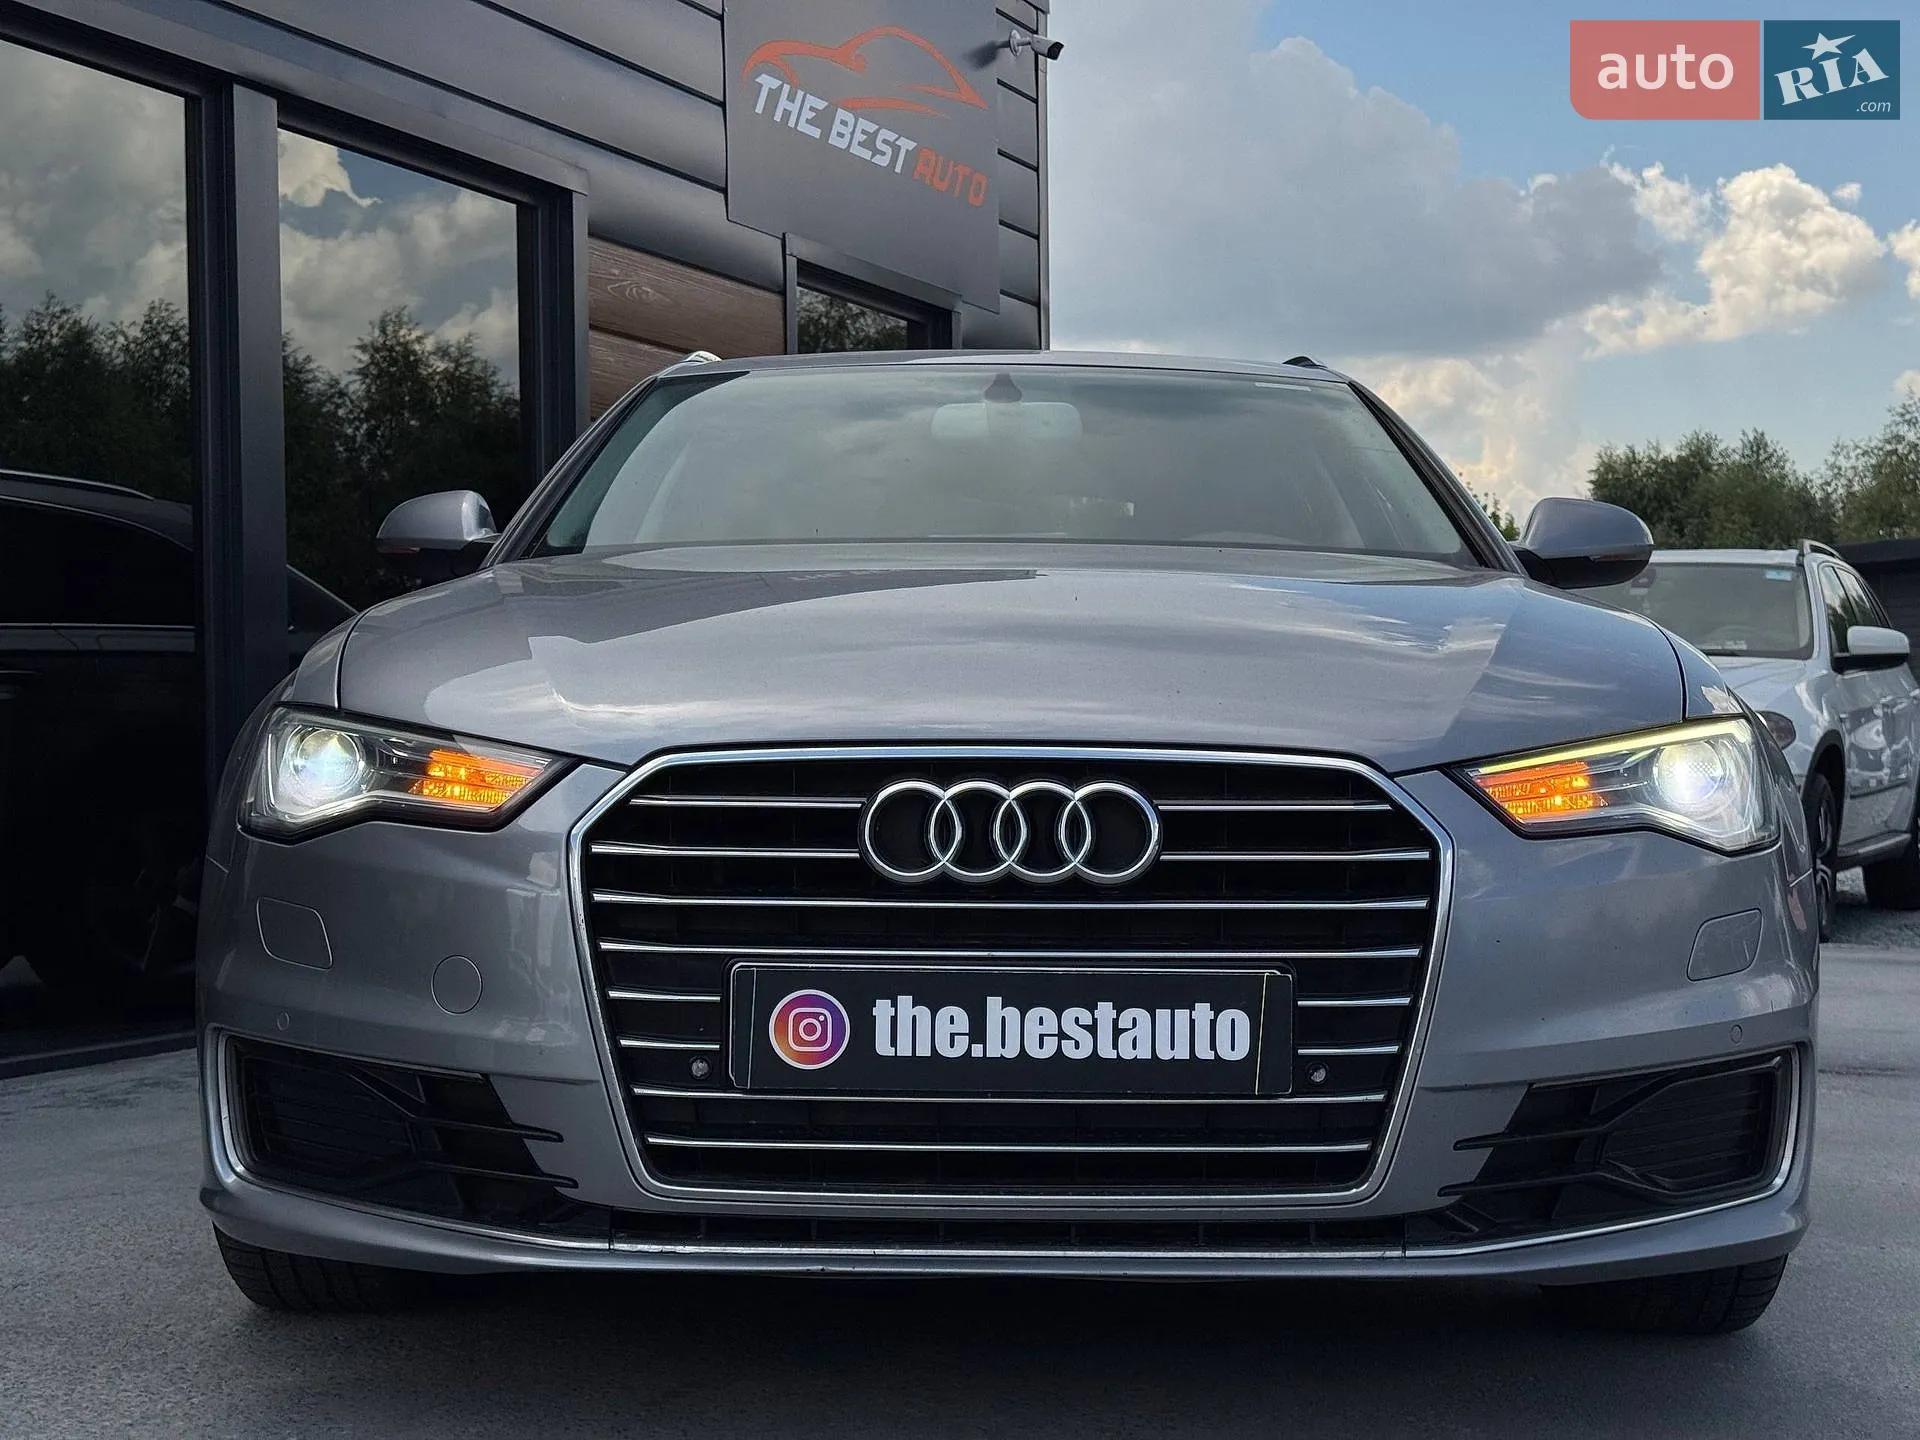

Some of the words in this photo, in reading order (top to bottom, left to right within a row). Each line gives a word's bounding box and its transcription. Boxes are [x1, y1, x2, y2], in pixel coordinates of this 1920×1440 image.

[755, 73, 829, 139] THE
[828, 107, 917, 173] BEST
[912, 147, 988, 207] AUTO
[873, 995, 1251, 1061] the.bestauto
